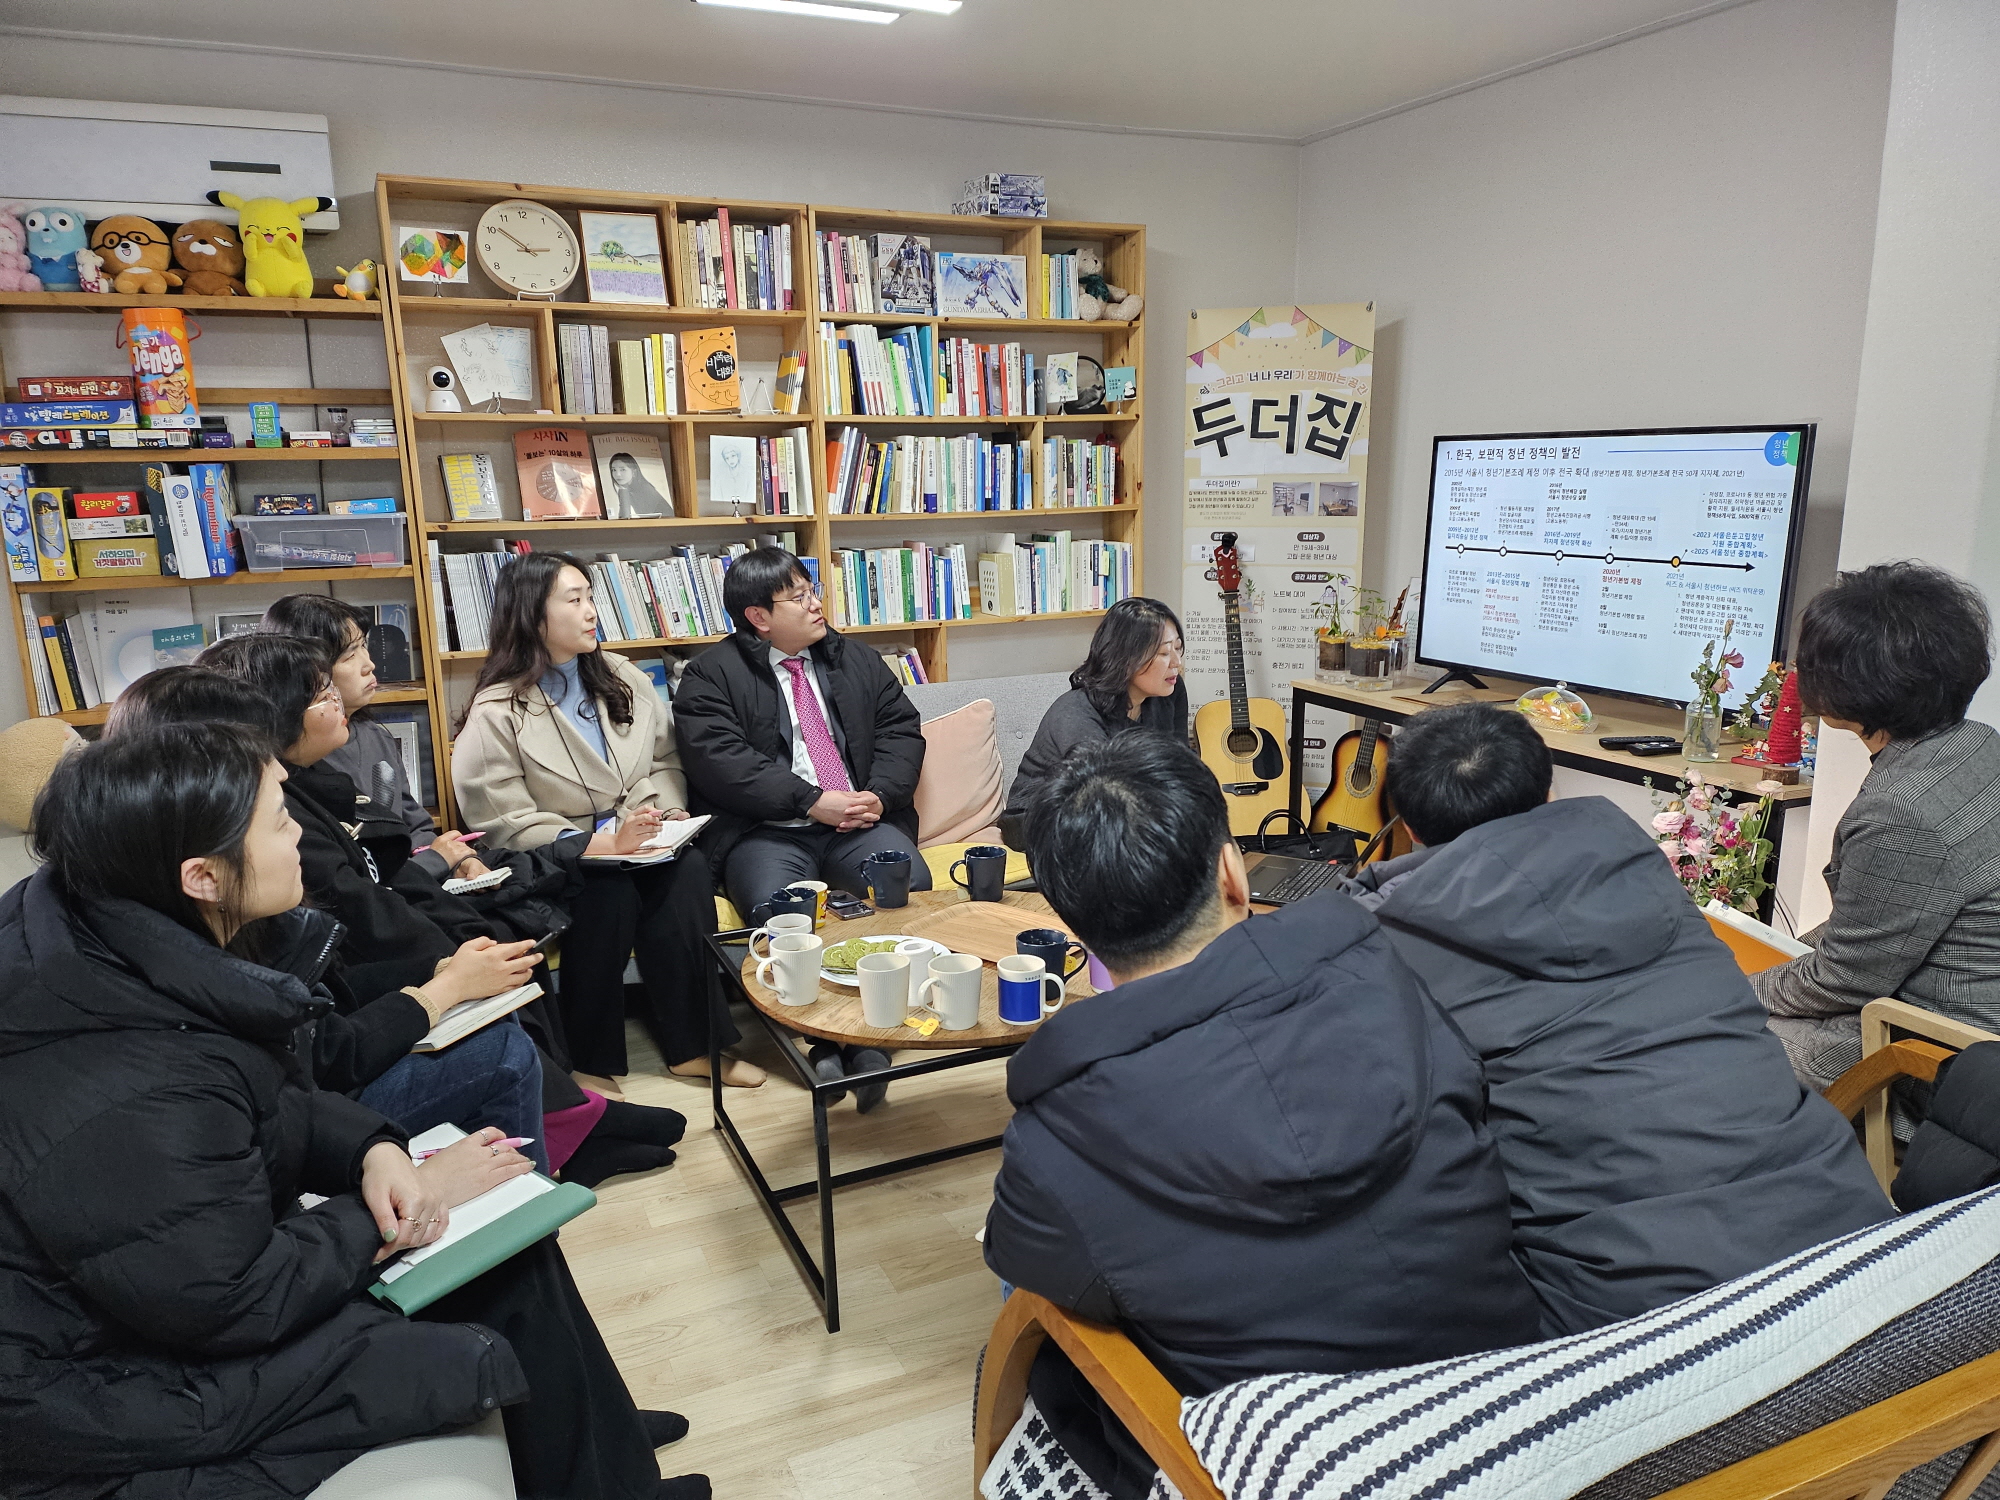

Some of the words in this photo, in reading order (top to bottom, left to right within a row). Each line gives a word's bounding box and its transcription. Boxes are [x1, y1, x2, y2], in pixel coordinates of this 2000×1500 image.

[499, 214, 508, 222] 11
[517, 211, 527, 220] 12
[486, 226, 497, 234] 10
[556, 231, 563, 239] 2
[132, 343, 184, 375] Jenga
[706, 352, 732, 366] 비폭력
[716, 366, 735, 379] 대화
[1215, 376, 1245, 389] 그리고
[1260, 370, 1271, 382] 나
[1306, 370, 1347, 385] 함께하는
[1348, 376, 1368, 396] 공간
[56, 385, 79, 396] 꼬치의
[80, 385, 99, 396] 달인
[38, 408, 110, 423] 텔레스트레이션
[1192, 394, 1363, 461] 두더집
[38, 430, 82, 445] CLUE
[532, 430, 569, 443] 시사IN
[1774, 439, 1789, 449] 청년
[548, 450, 570, 458] 10살의
[570, 450, 583, 458] 하루
[1446, 450, 1453, 460] 1.
[1456, 449, 1475, 462] 한국,
[1477, 448, 1504, 460] 보편적
[1507, 448, 1526, 460] 청년
[1529, 446, 1558, 460] 정책의
[1561, 446, 1582, 459] 발전
[1772, 449, 1788, 459] 정책
[458, 454, 475, 475] THE
[1444, 468, 1464, 478] 2015년
[1465, 468, 1484, 478] 서울시
[1485, 468, 1524, 477] 청년기본조례
[1526, 467, 1540, 477] 제정
[1542, 467, 1556, 477] 이후
[1558, 467, 1572, 477] 전국
[1574, 467, 1590, 477] 확대
[1635, 470, 1670, 478] 청년기본조례
[1672, 470, 1684, 478] 전국
[1685, 469, 1699, 478] 50개
[444, 456, 471, 517] MANIFESTO
[463, 476, 482, 506] CARE
[80, 499, 115, 511] 할리갈리
[201, 486, 222, 544] Rummikub
[1712, 531, 1764, 542] 서울은둔고립청년
[98, 548, 135, 558] 서하의집
[1710, 548, 1736, 557] 서울청년
[1602, 576, 1630, 585] 청년기본법
[1684, 582, 1703, 590] 서울시
[1704, 583, 1728, 592] 청년허브
